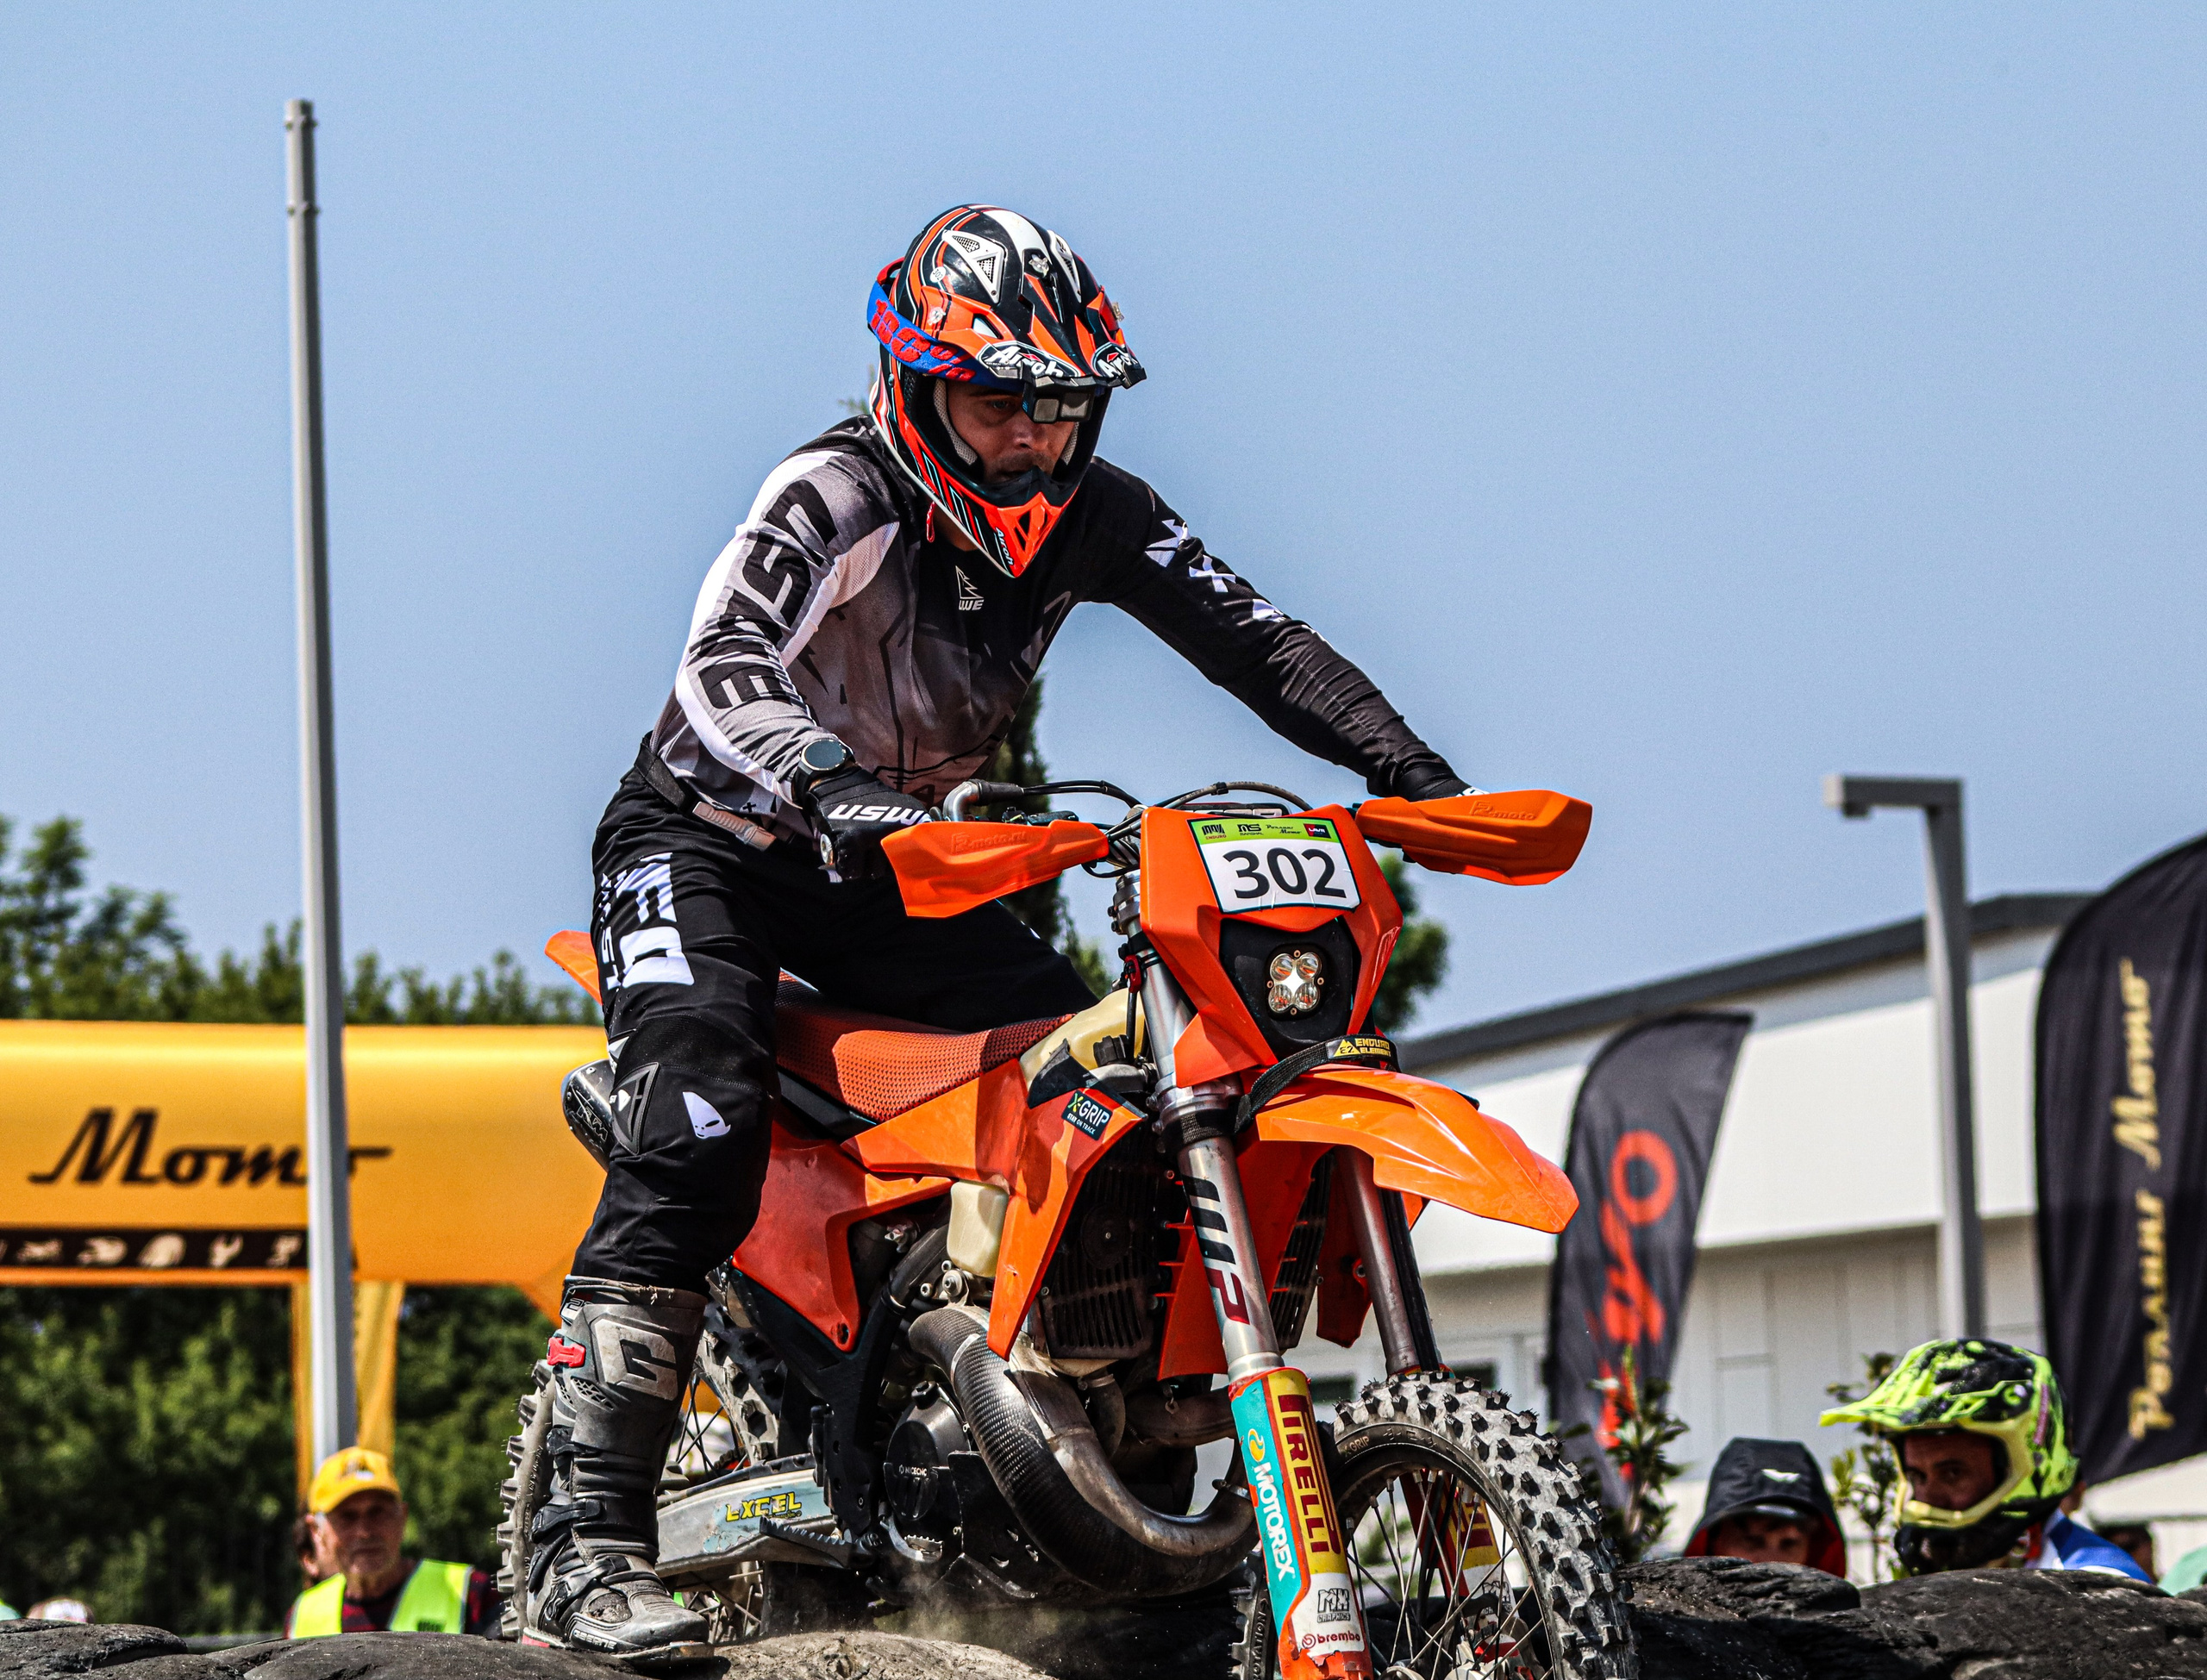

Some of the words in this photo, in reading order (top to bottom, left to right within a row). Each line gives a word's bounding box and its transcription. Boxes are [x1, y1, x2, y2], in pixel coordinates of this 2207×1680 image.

[1222, 847, 1347, 899] 302
[1340, 1046, 1354, 1054] E2
[1354, 1038, 1390, 1050] ENDURO
[1360, 1046, 1391, 1057] ELEMENT
[1066, 1112, 1078, 1123] STAY
[1076, 1118, 1083, 1127] ON
[1082, 1122, 1096, 1135] TRACK
[1278, 1393, 1341, 1555] PIRELLI
[1254, 1462, 1295, 1582] MOTOREX
[1318, 1588, 1349, 1613] MX
[1317, 1613, 1351, 1623] GRAPHICS
[1316, 1630, 1361, 1644] brembo
